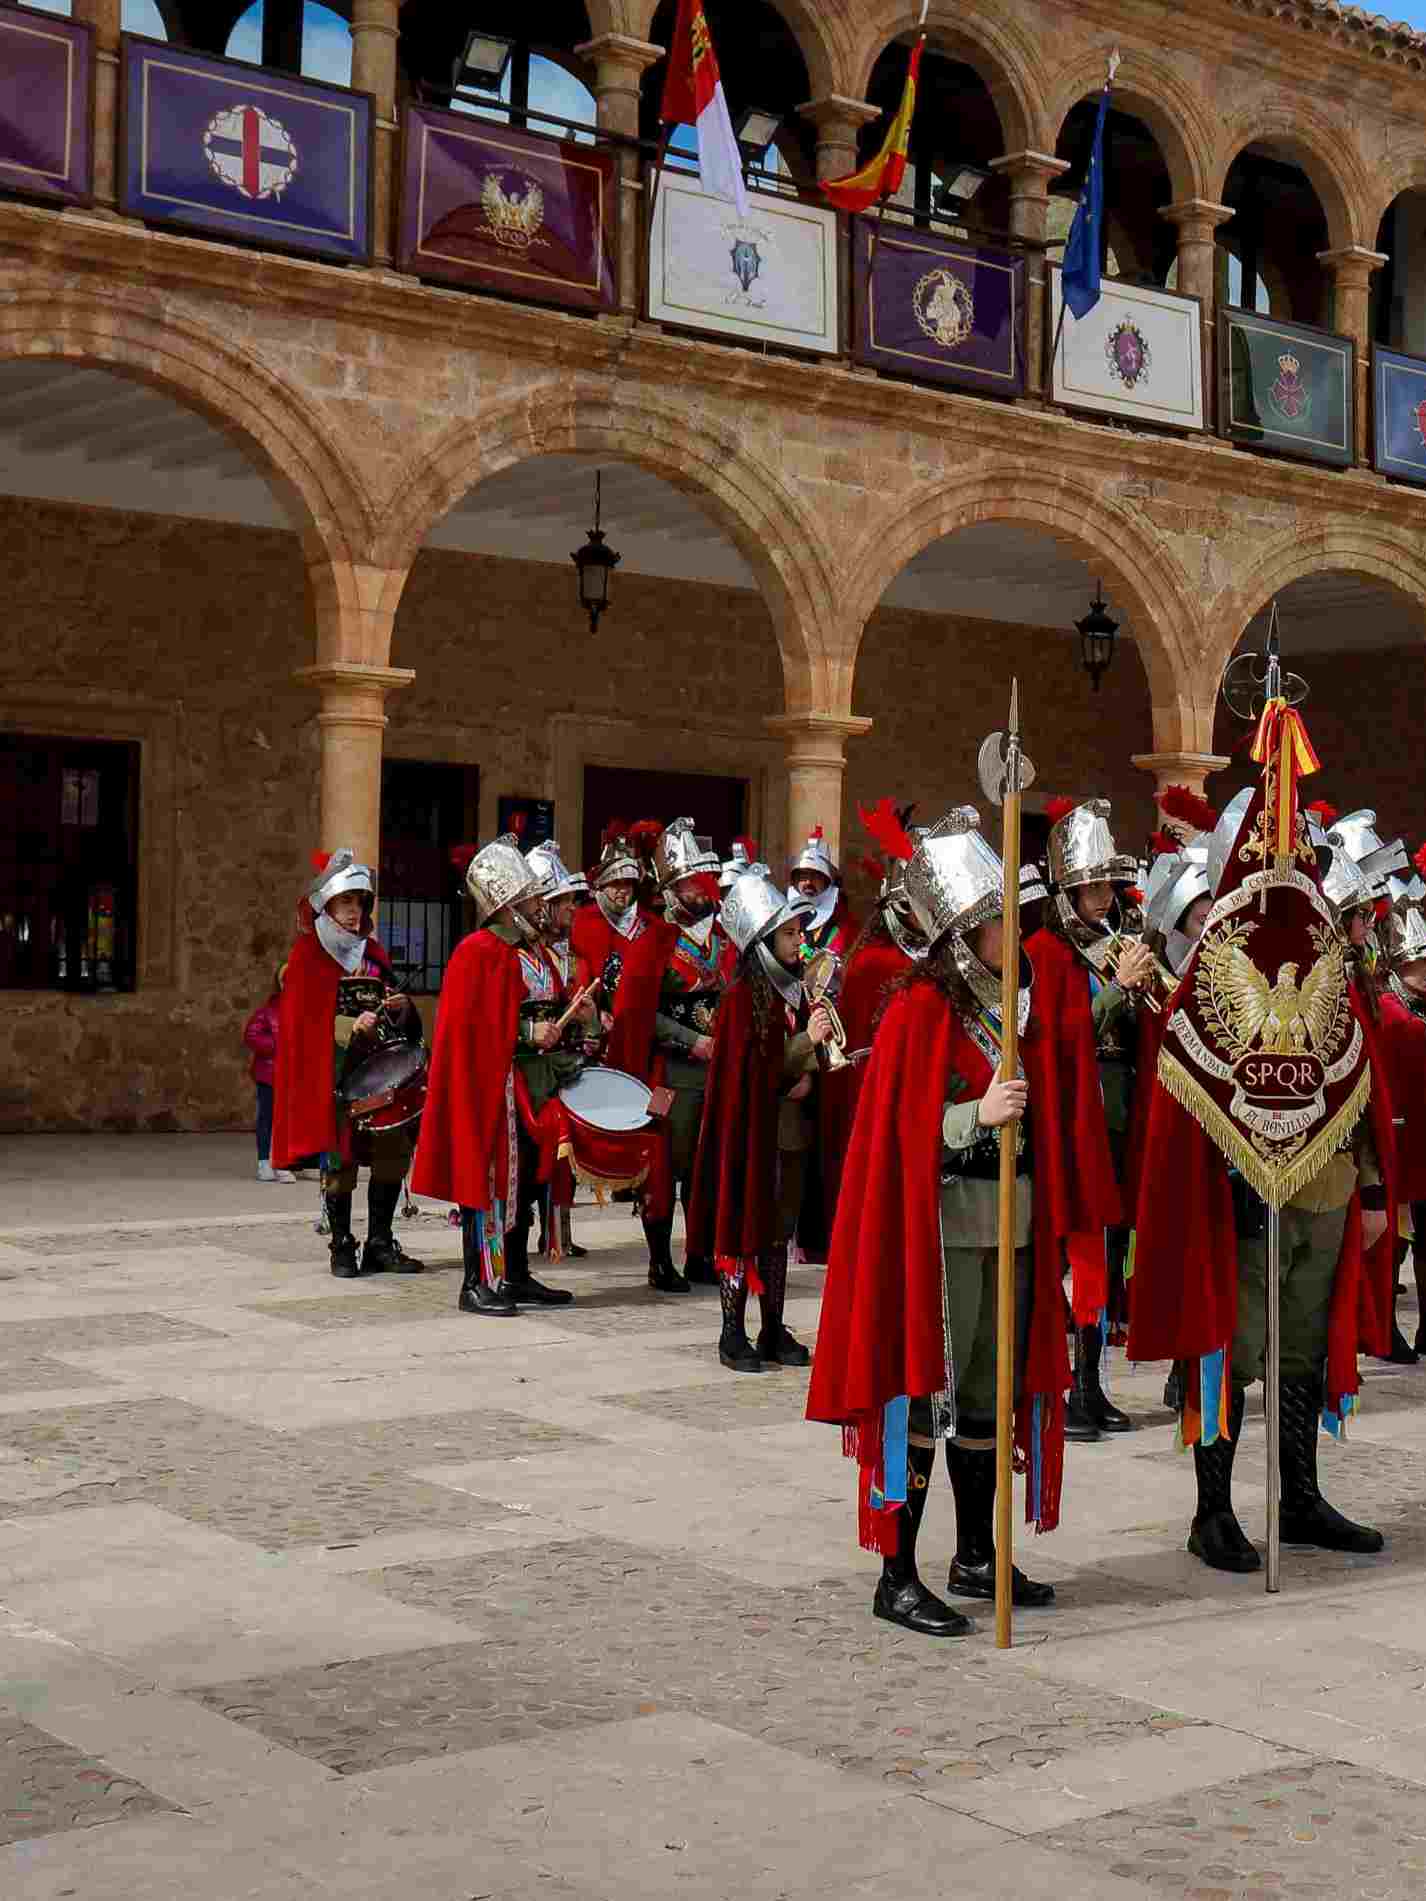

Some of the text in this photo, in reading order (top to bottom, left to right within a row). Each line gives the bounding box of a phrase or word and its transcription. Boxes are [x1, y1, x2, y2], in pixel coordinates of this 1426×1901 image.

[1174, 1017, 1228, 1077] HERMANDAD
[1244, 1109, 1312, 1134] EL BONILLO
